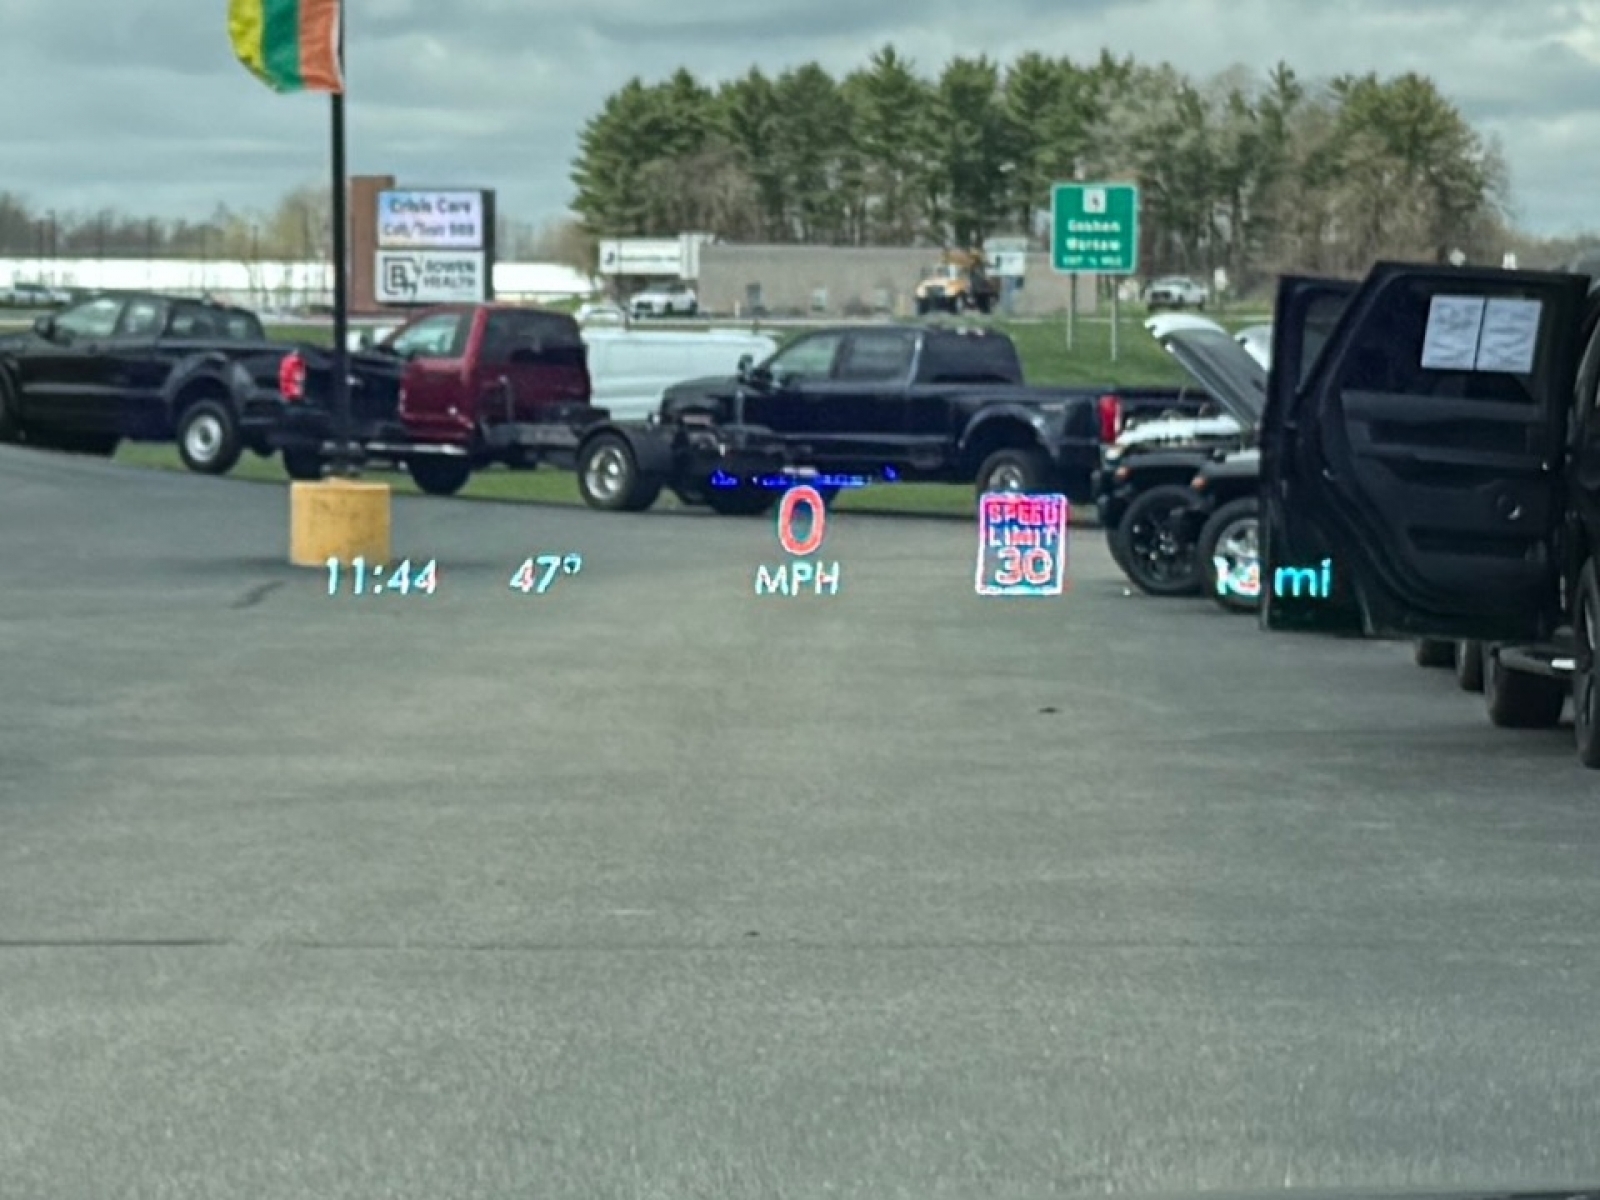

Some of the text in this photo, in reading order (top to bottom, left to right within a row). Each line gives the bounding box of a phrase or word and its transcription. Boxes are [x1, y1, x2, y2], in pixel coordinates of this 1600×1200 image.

[437, 198, 471, 213] Care
[778, 485, 826, 555] 0
[987, 502, 1059, 525] SPEED
[989, 524, 1058, 547] LIMIT
[326, 556, 437, 595] 11:44
[755, 561, 840, 596] MPH
[994, 547, 1053, 585] 30
[1274, 558, 1332, 598] mi
